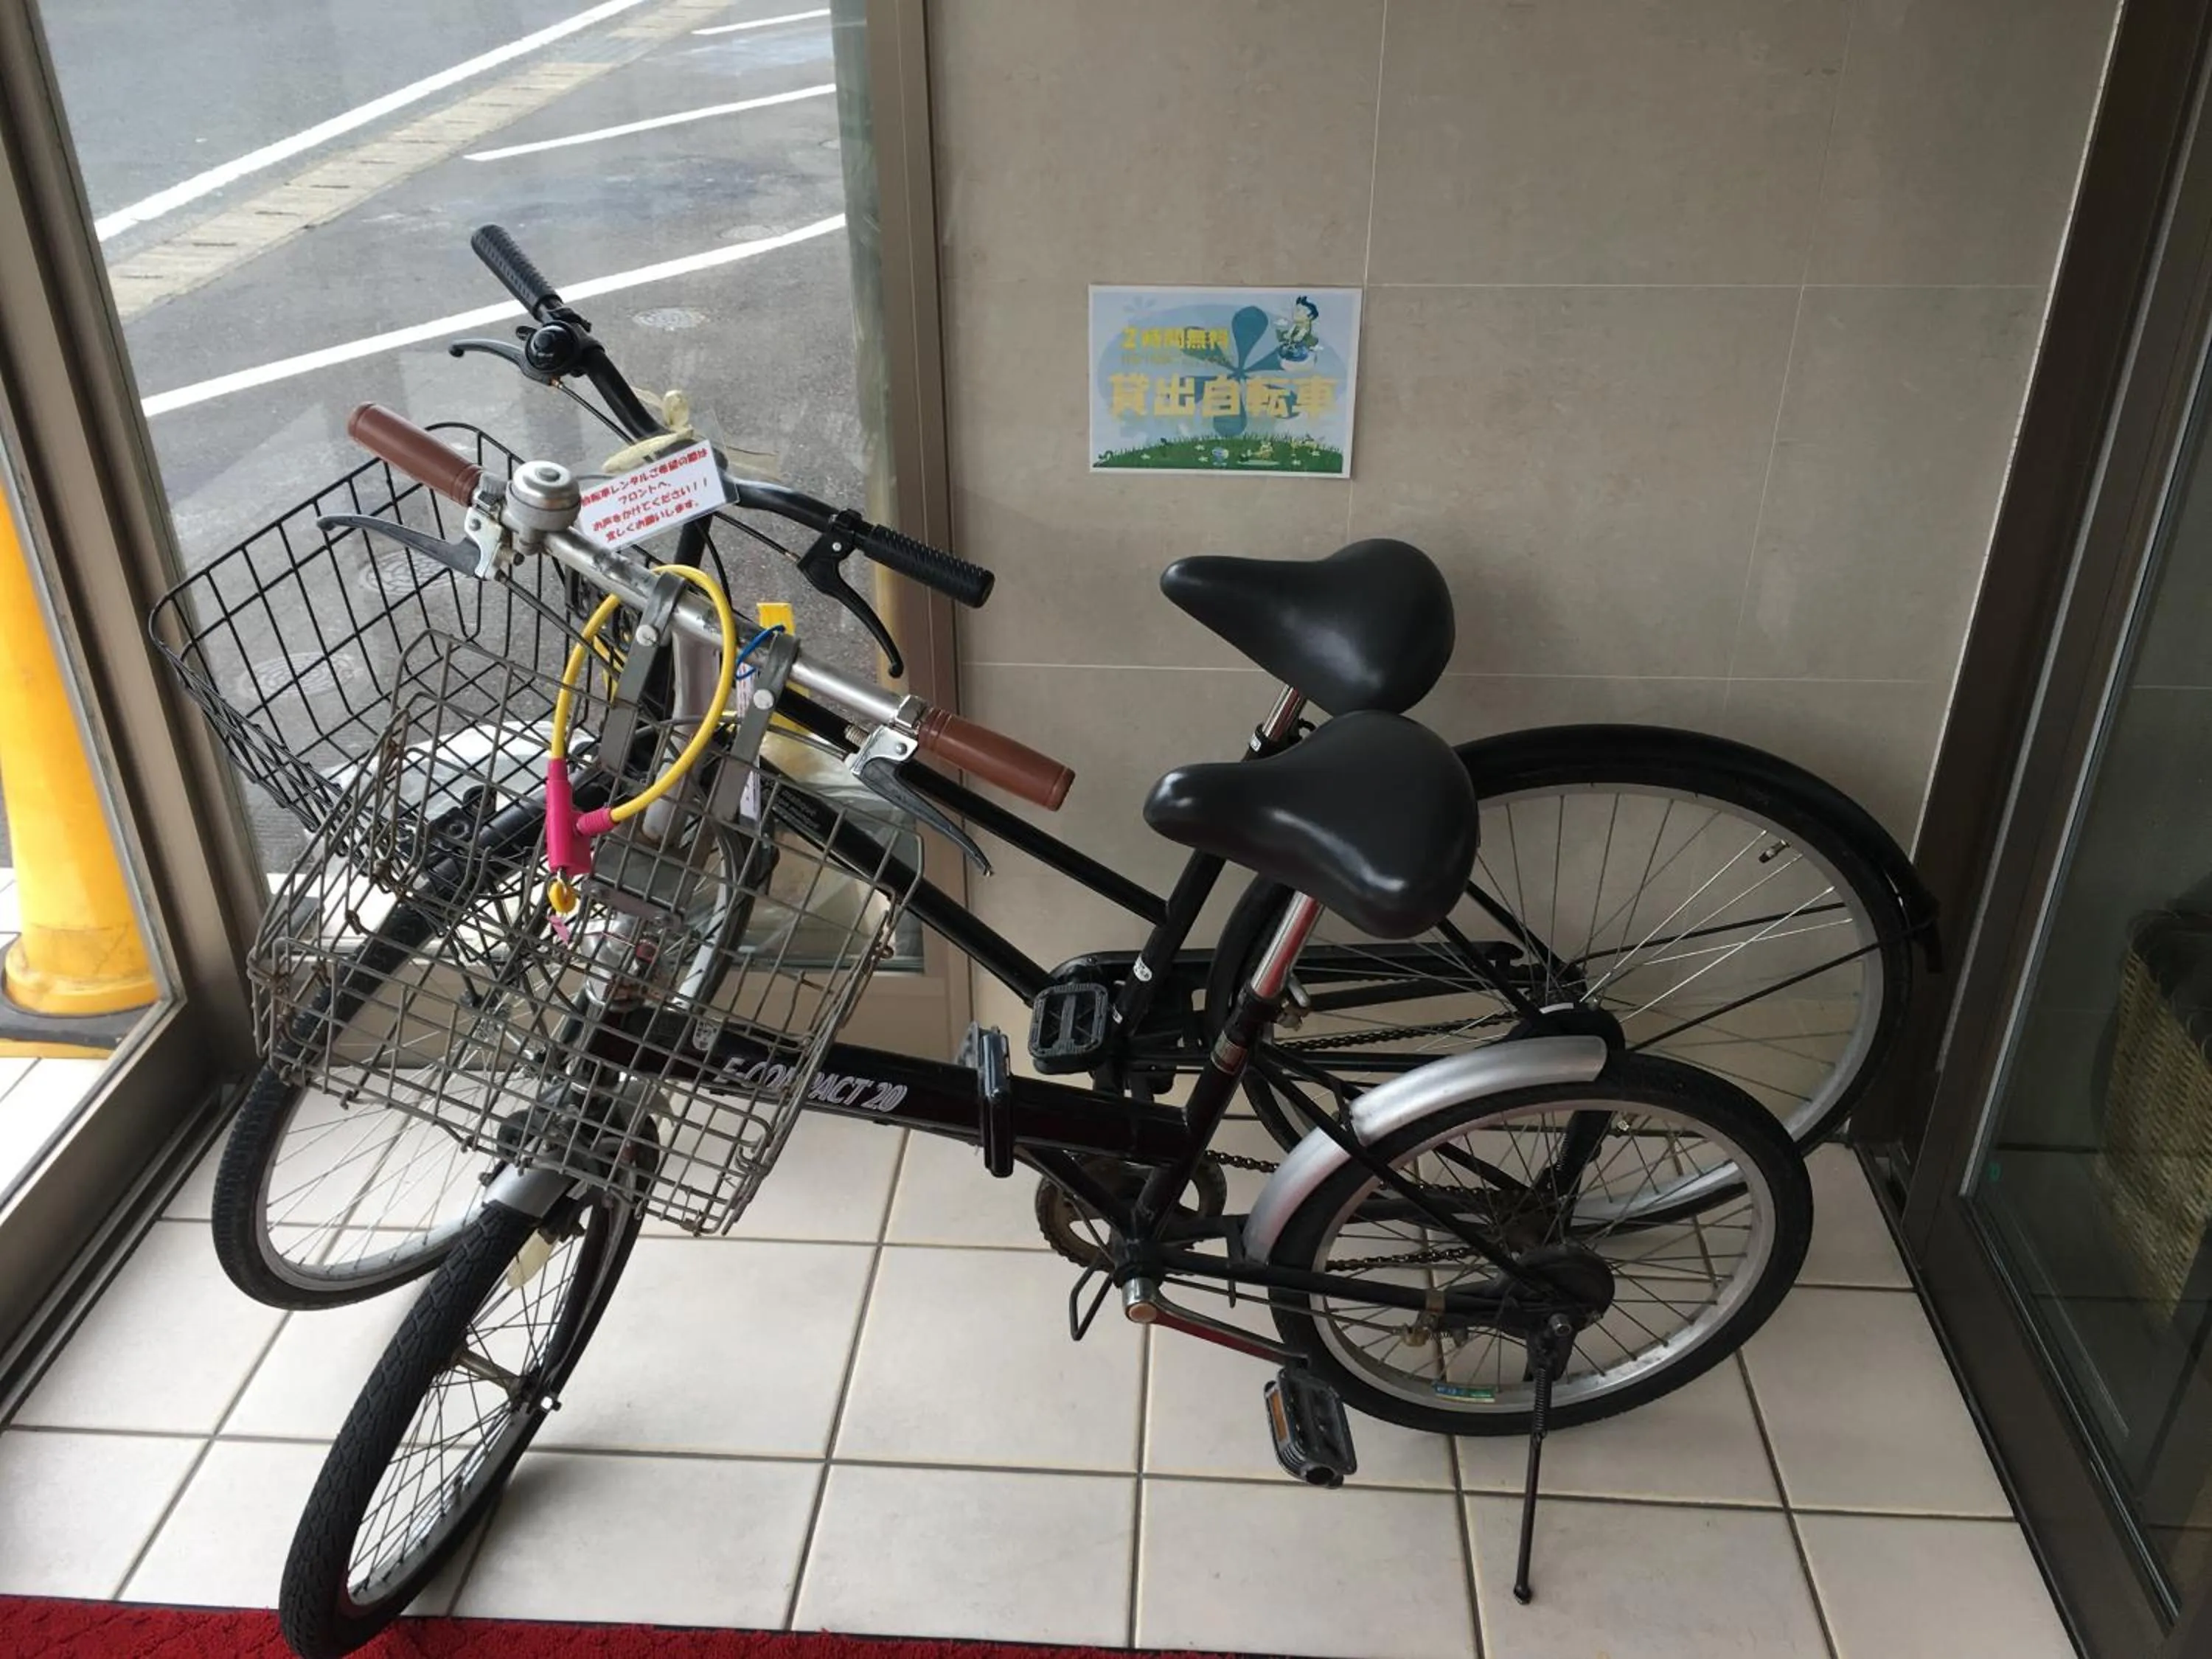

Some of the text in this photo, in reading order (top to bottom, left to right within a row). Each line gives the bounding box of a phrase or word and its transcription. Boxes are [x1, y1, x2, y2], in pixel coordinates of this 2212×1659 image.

[1109, 372, 1340, 418] 貸出自転車
[860, 1082, 908, 1113] 20
